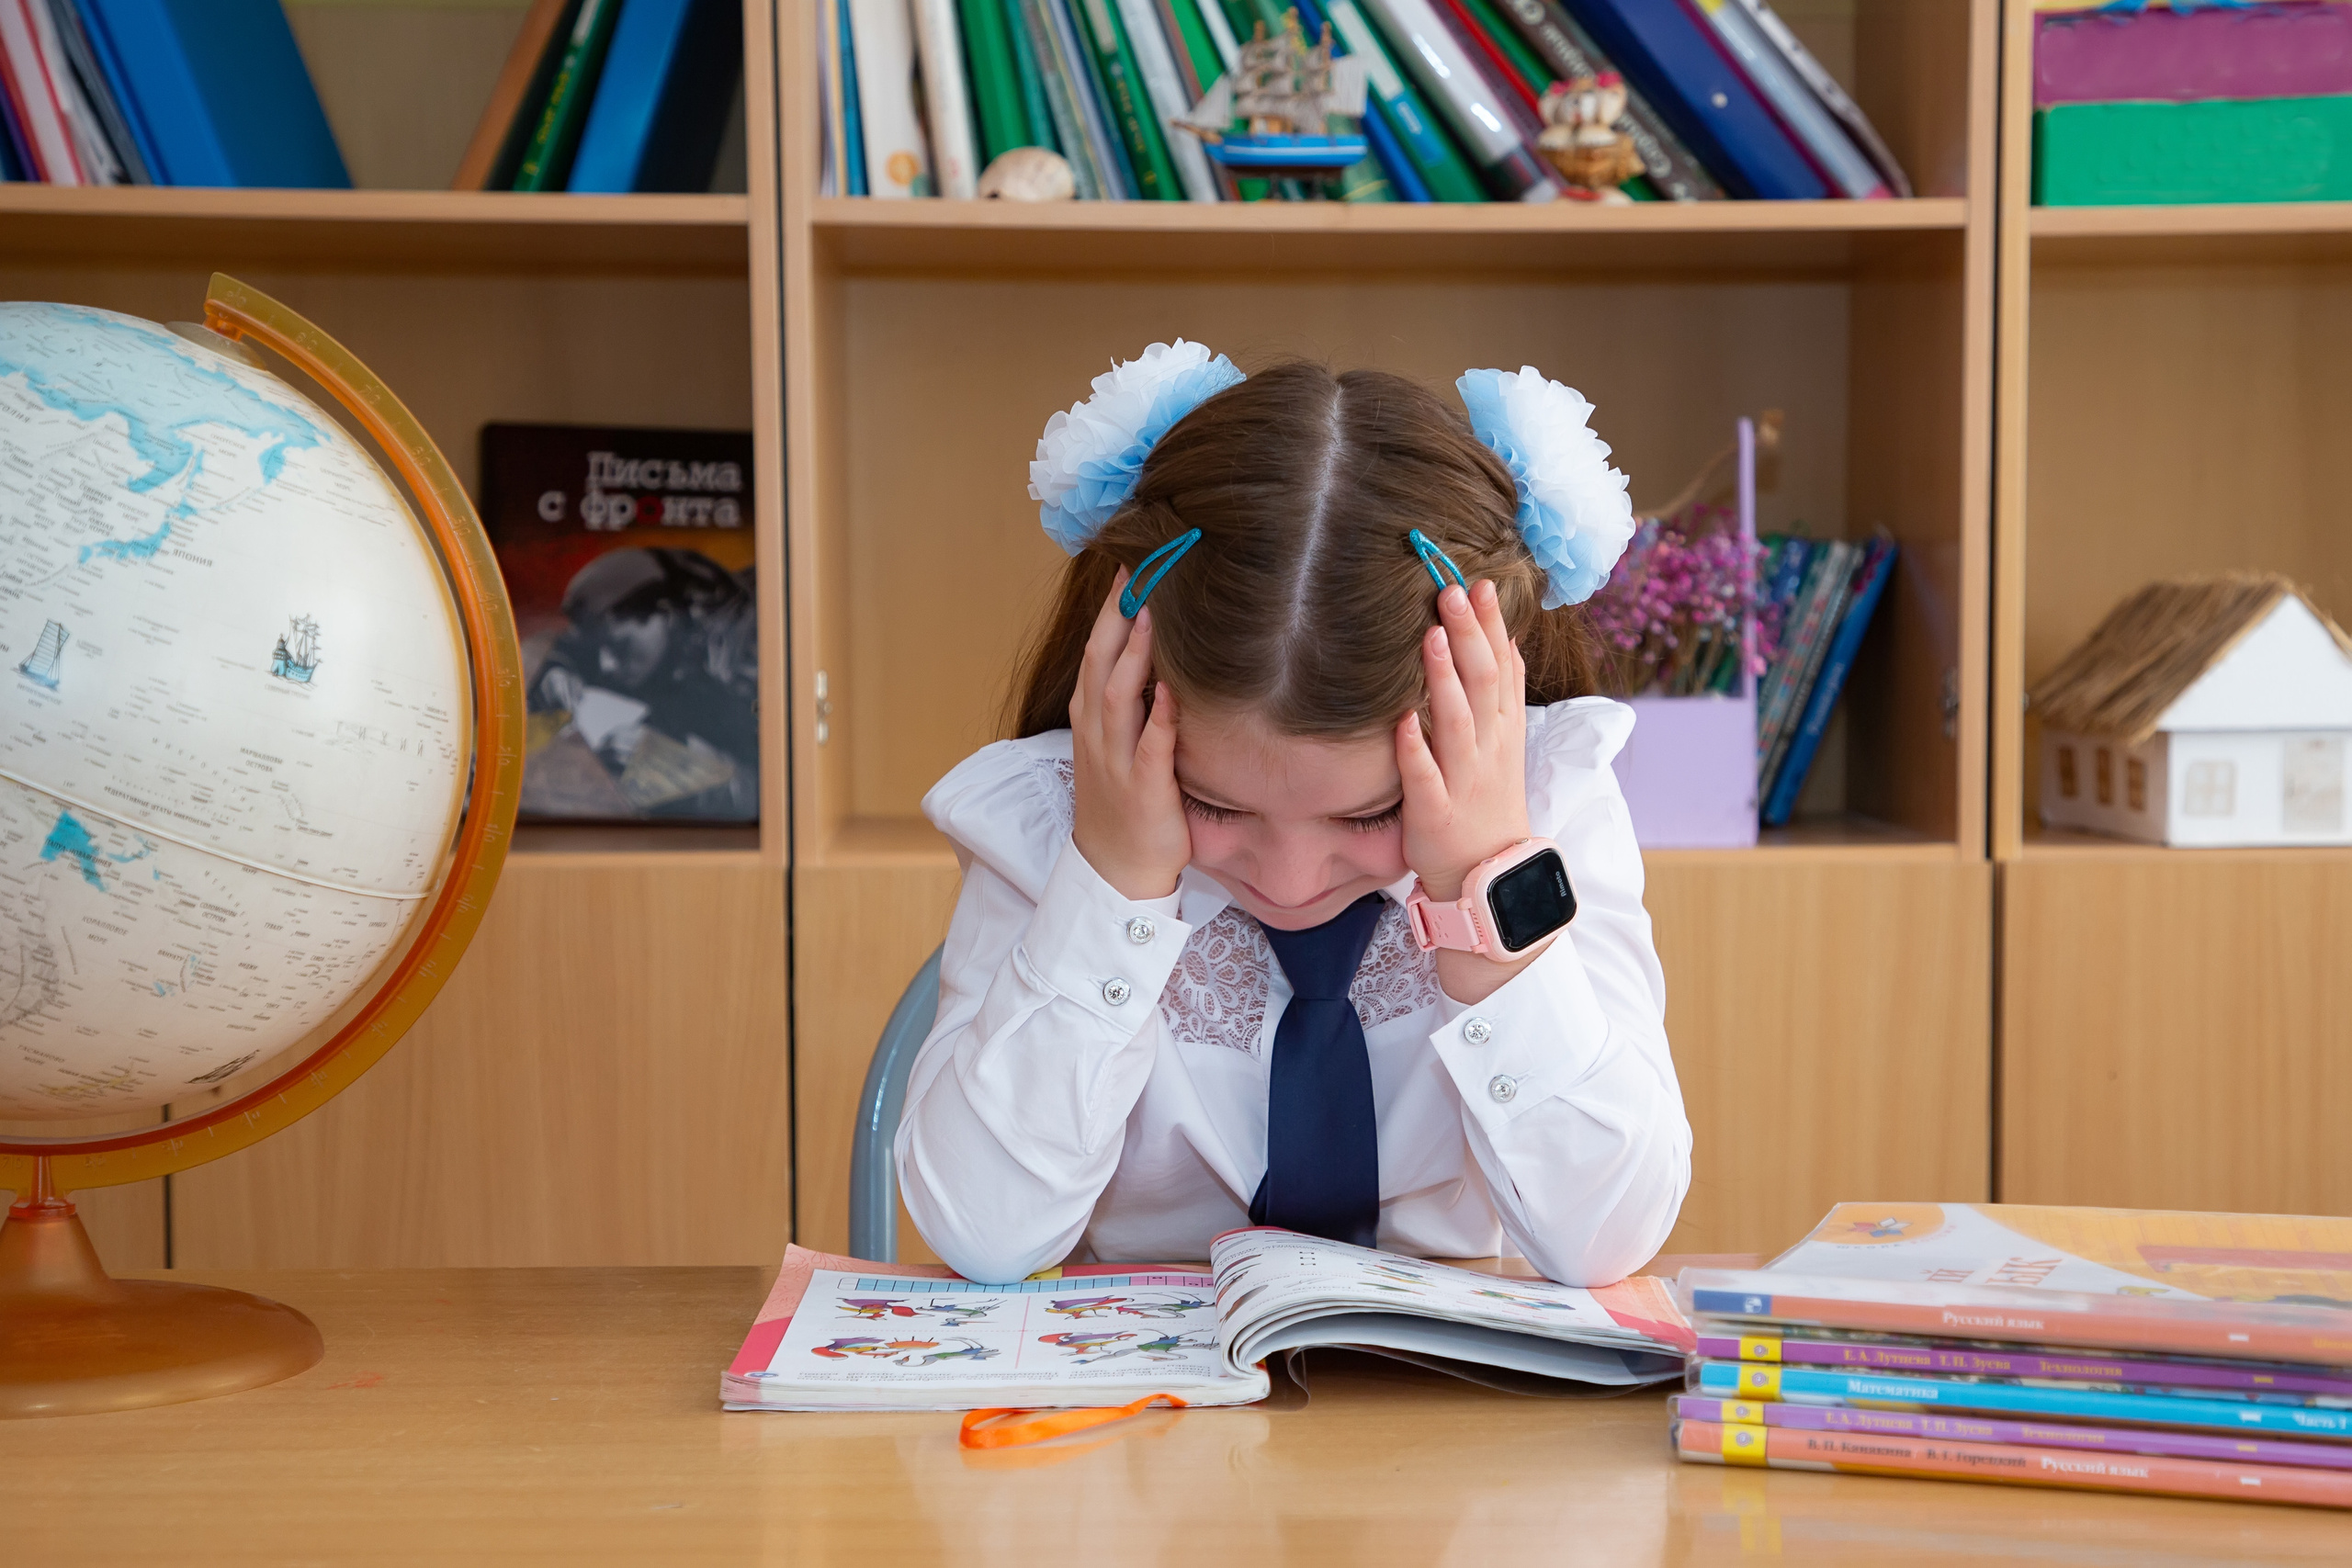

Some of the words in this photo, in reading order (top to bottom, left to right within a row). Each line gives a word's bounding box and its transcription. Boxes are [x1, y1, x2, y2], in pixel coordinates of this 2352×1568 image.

[586, 452, 743, 491] Письма
[537, 491, 566, 522] с
[580, 486, 741, 532] фронта
[172, 547, 212, 570] ЯПОНИЯ
[1555, 871, 1567, 897] Aimoto
[1942, 1311, 2004, 1329] Русский
[2007, 1316, 2044, 1331] язык
[1873, 1351, 1931, 1370] Лутцева
[1971, 1357, 2011, 1372] Зуева
[2039, 1359, 2123, 1377] Технология
[1847, 1380, 1939, 1400] Математика
[1953, 1421, 1993, 1438] Зуева
[2021, 1426, 2106, 1444] Технология
[1840, 1441, 1912, 1459] Канакина
[1955, 1449, 2027, 1469] Горецкий
[2040, 1456, 2107, 1475] Русский
[2109, 1462, 2150, 1480] язык
